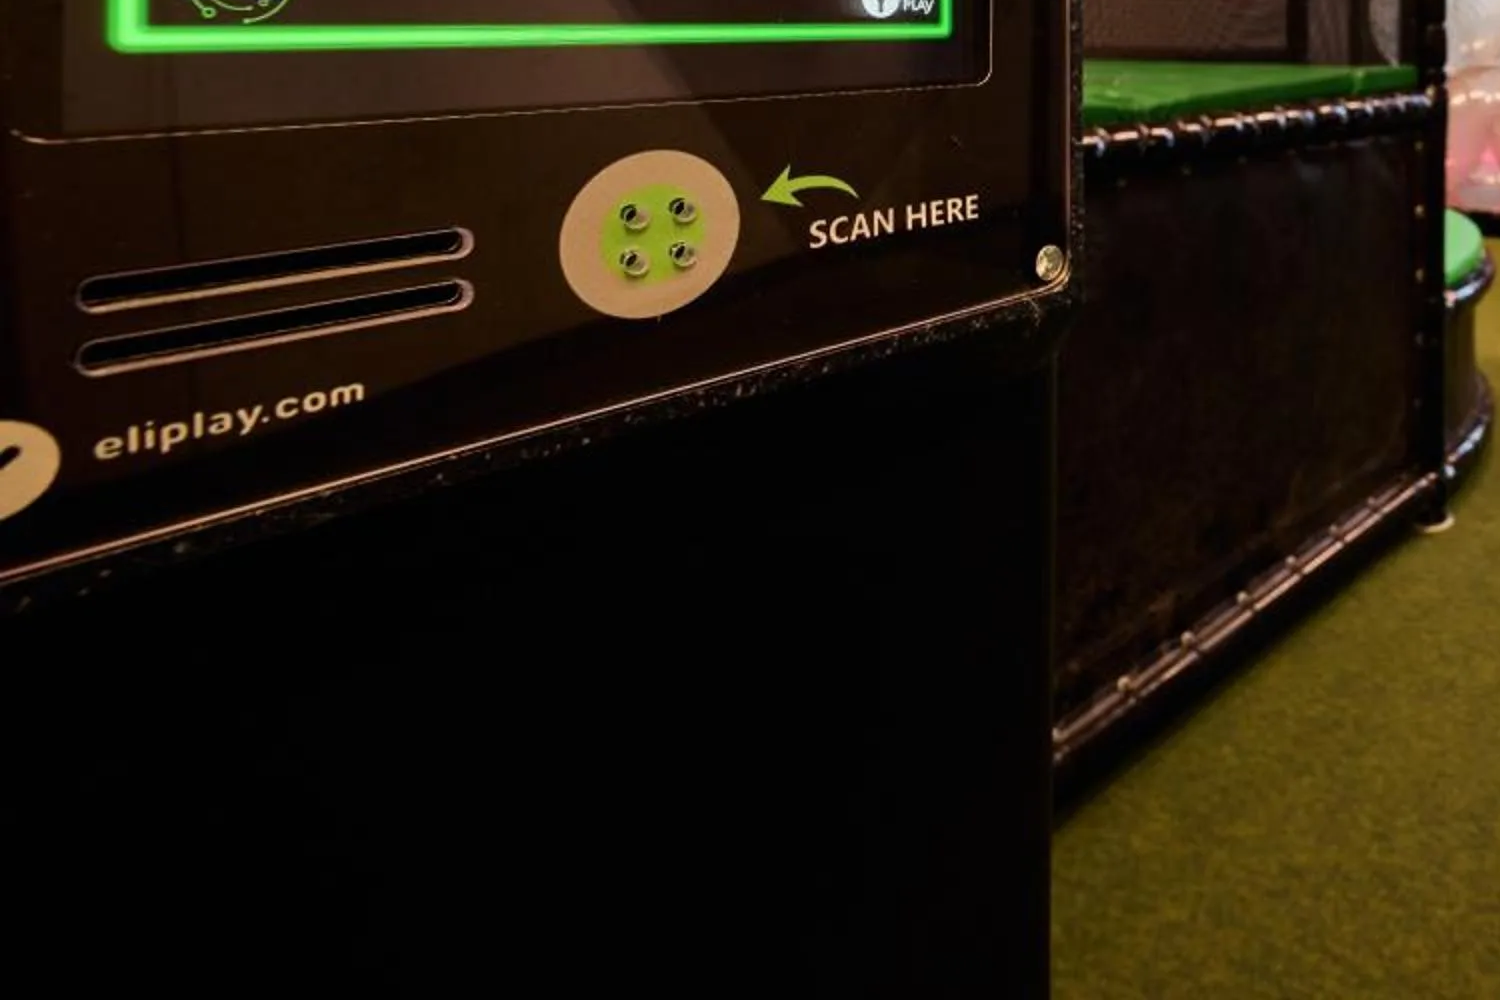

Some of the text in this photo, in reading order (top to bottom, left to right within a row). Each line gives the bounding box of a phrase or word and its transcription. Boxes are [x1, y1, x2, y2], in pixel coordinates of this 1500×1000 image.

[808, 194, 979, 249] SCAN HERE
[94, 382, 365, 460] eliplay.com
